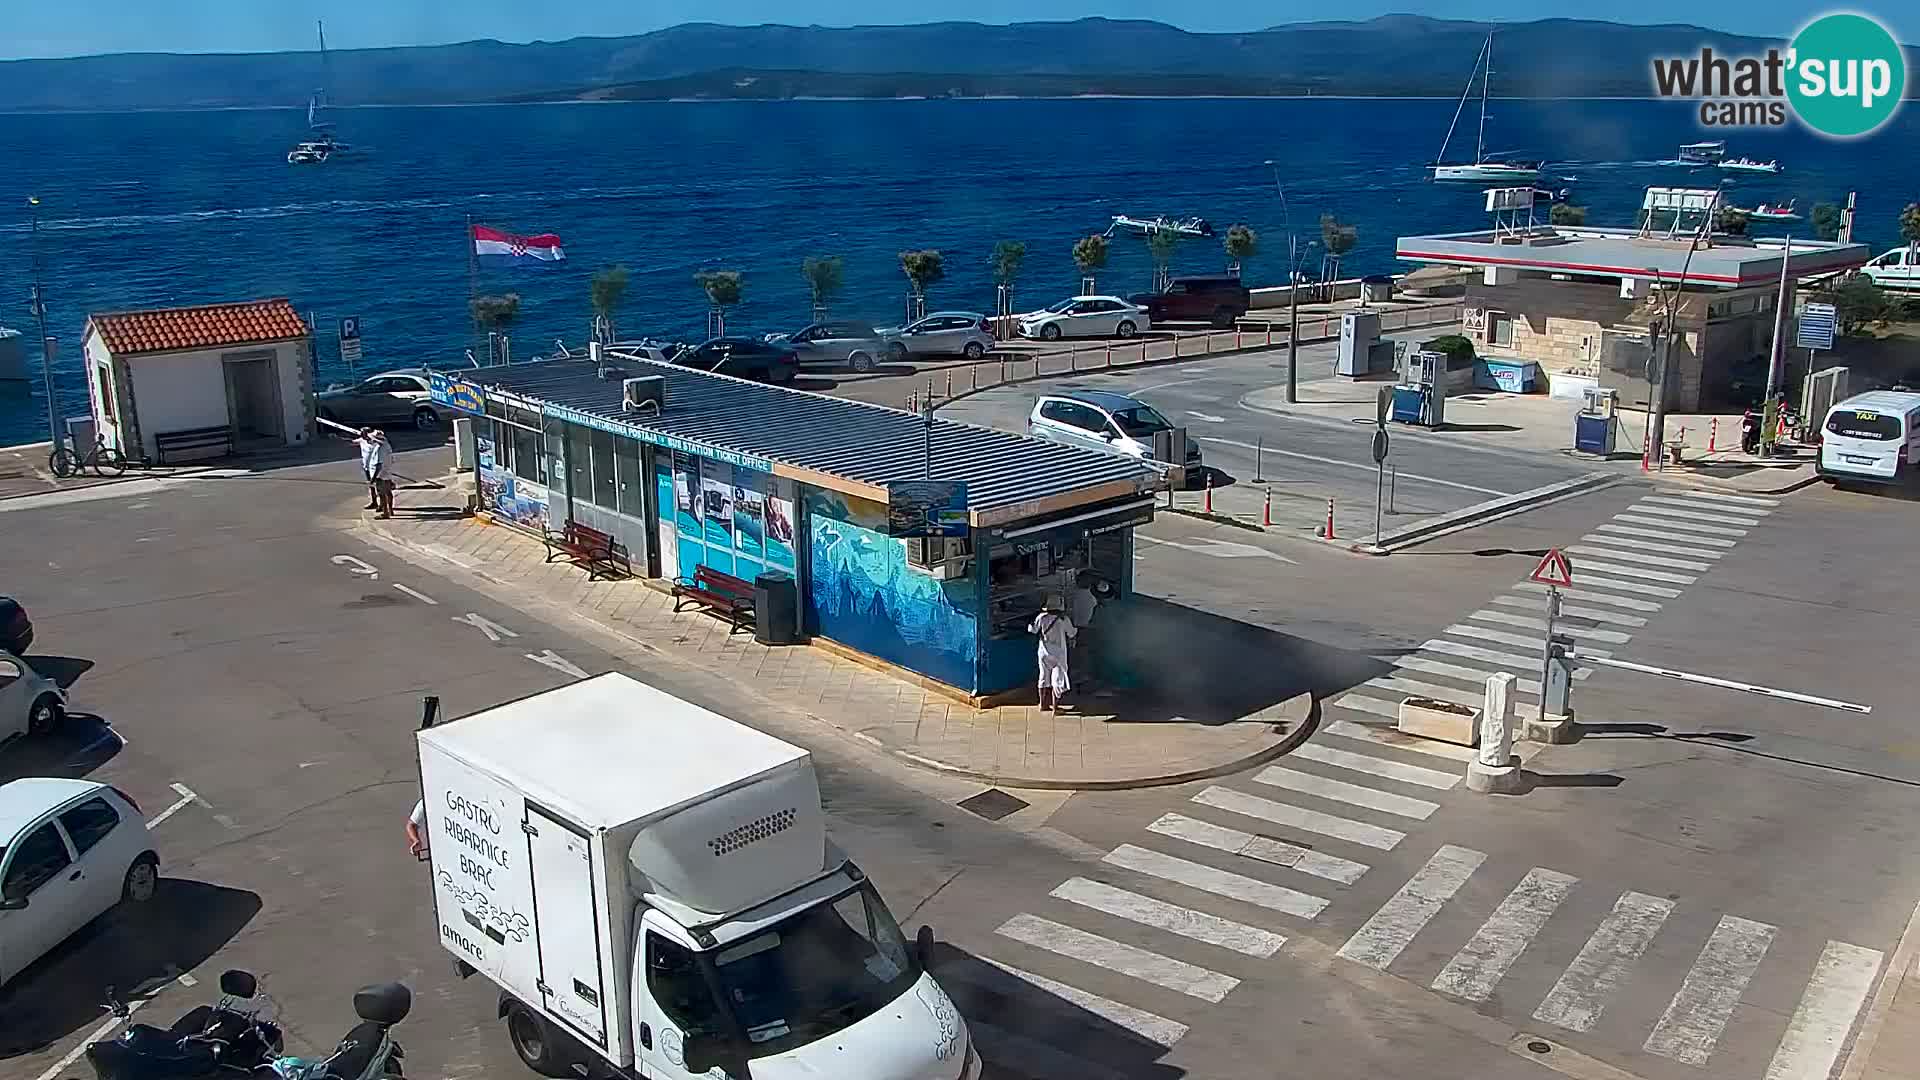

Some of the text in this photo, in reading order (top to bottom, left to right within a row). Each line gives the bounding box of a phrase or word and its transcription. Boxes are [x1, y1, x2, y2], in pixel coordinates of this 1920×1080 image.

[343, 319, 355, 337] P
[1855, 411, 1878, 421] TAXI
[627, 427, 659, 442] POSTAJA
[667, 437, 768, 470] BUS STATION TICKET OFFICE
[446, 790, 502, 835] GASTRO
[443, 816, 510, 870] RIBARNICE
